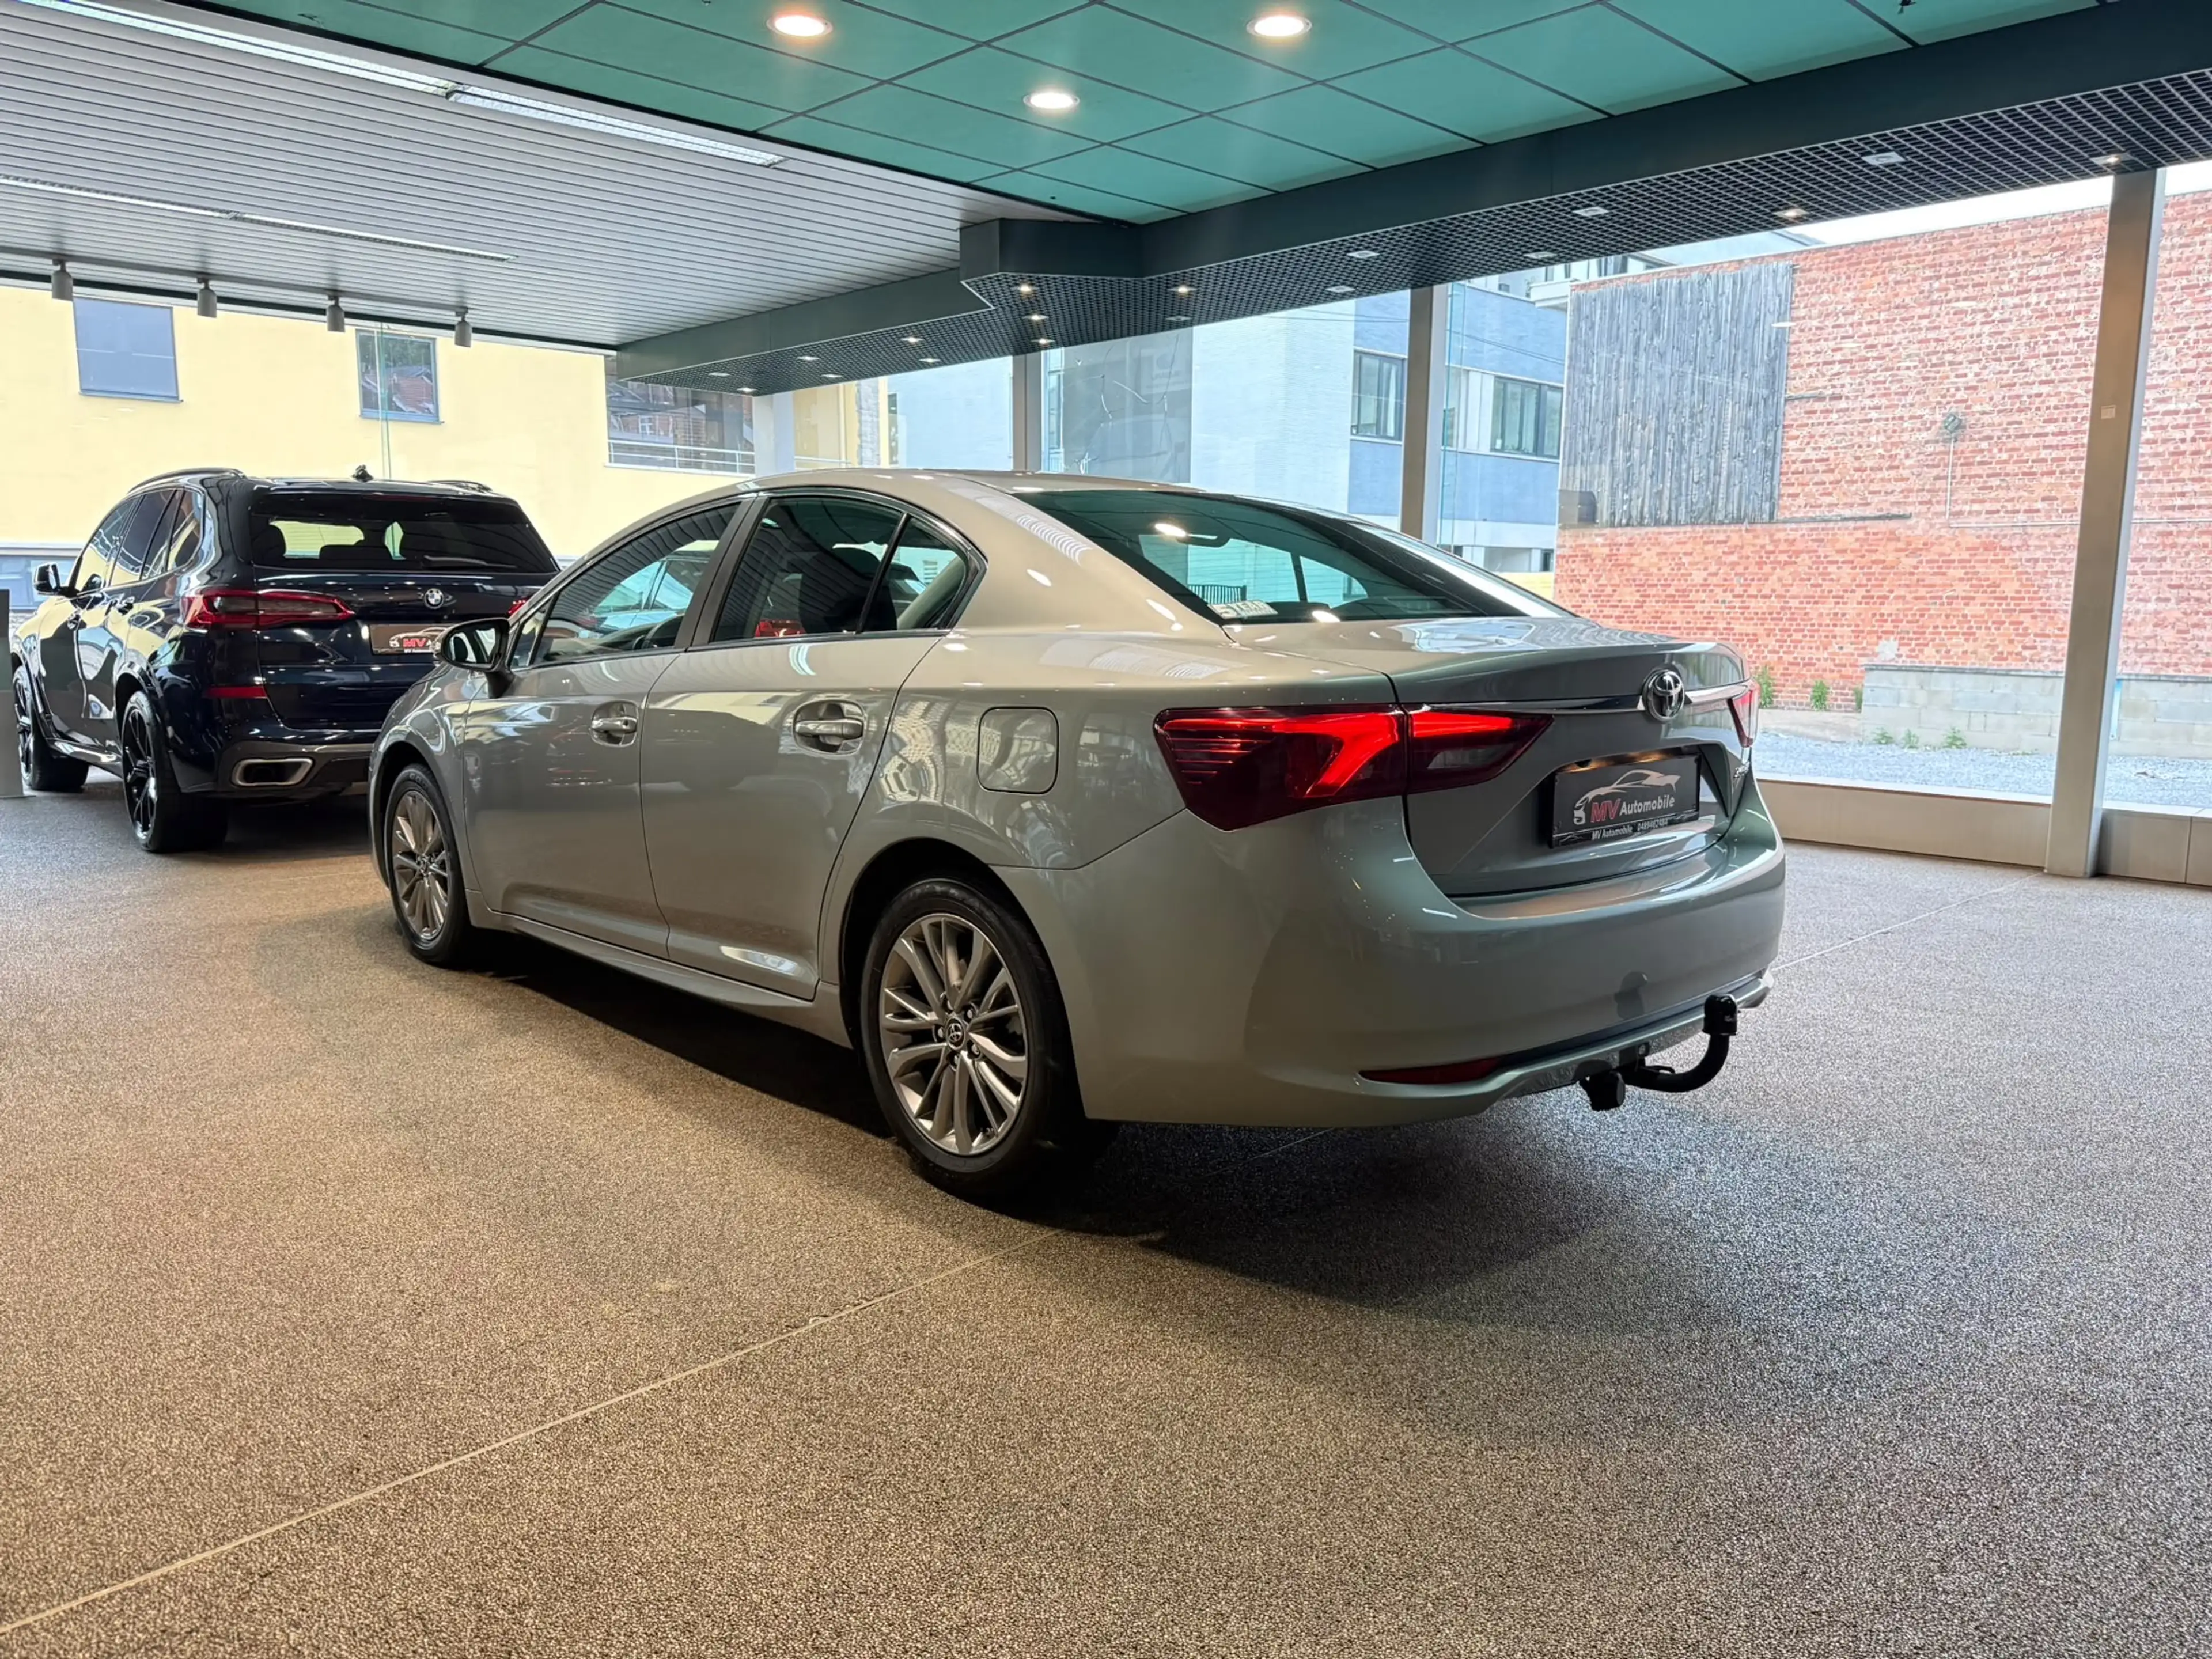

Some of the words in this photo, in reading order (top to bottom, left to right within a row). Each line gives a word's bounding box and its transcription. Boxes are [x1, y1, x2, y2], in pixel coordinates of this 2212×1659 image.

[403, 638, 427, 648] MV
[1590, 798, 1621, 823] MV
[1619, 794, 1675, 816] Automobile
[1592, 830, 1602, 840] MV
[1601, 824, 1633, 838] Automobile
